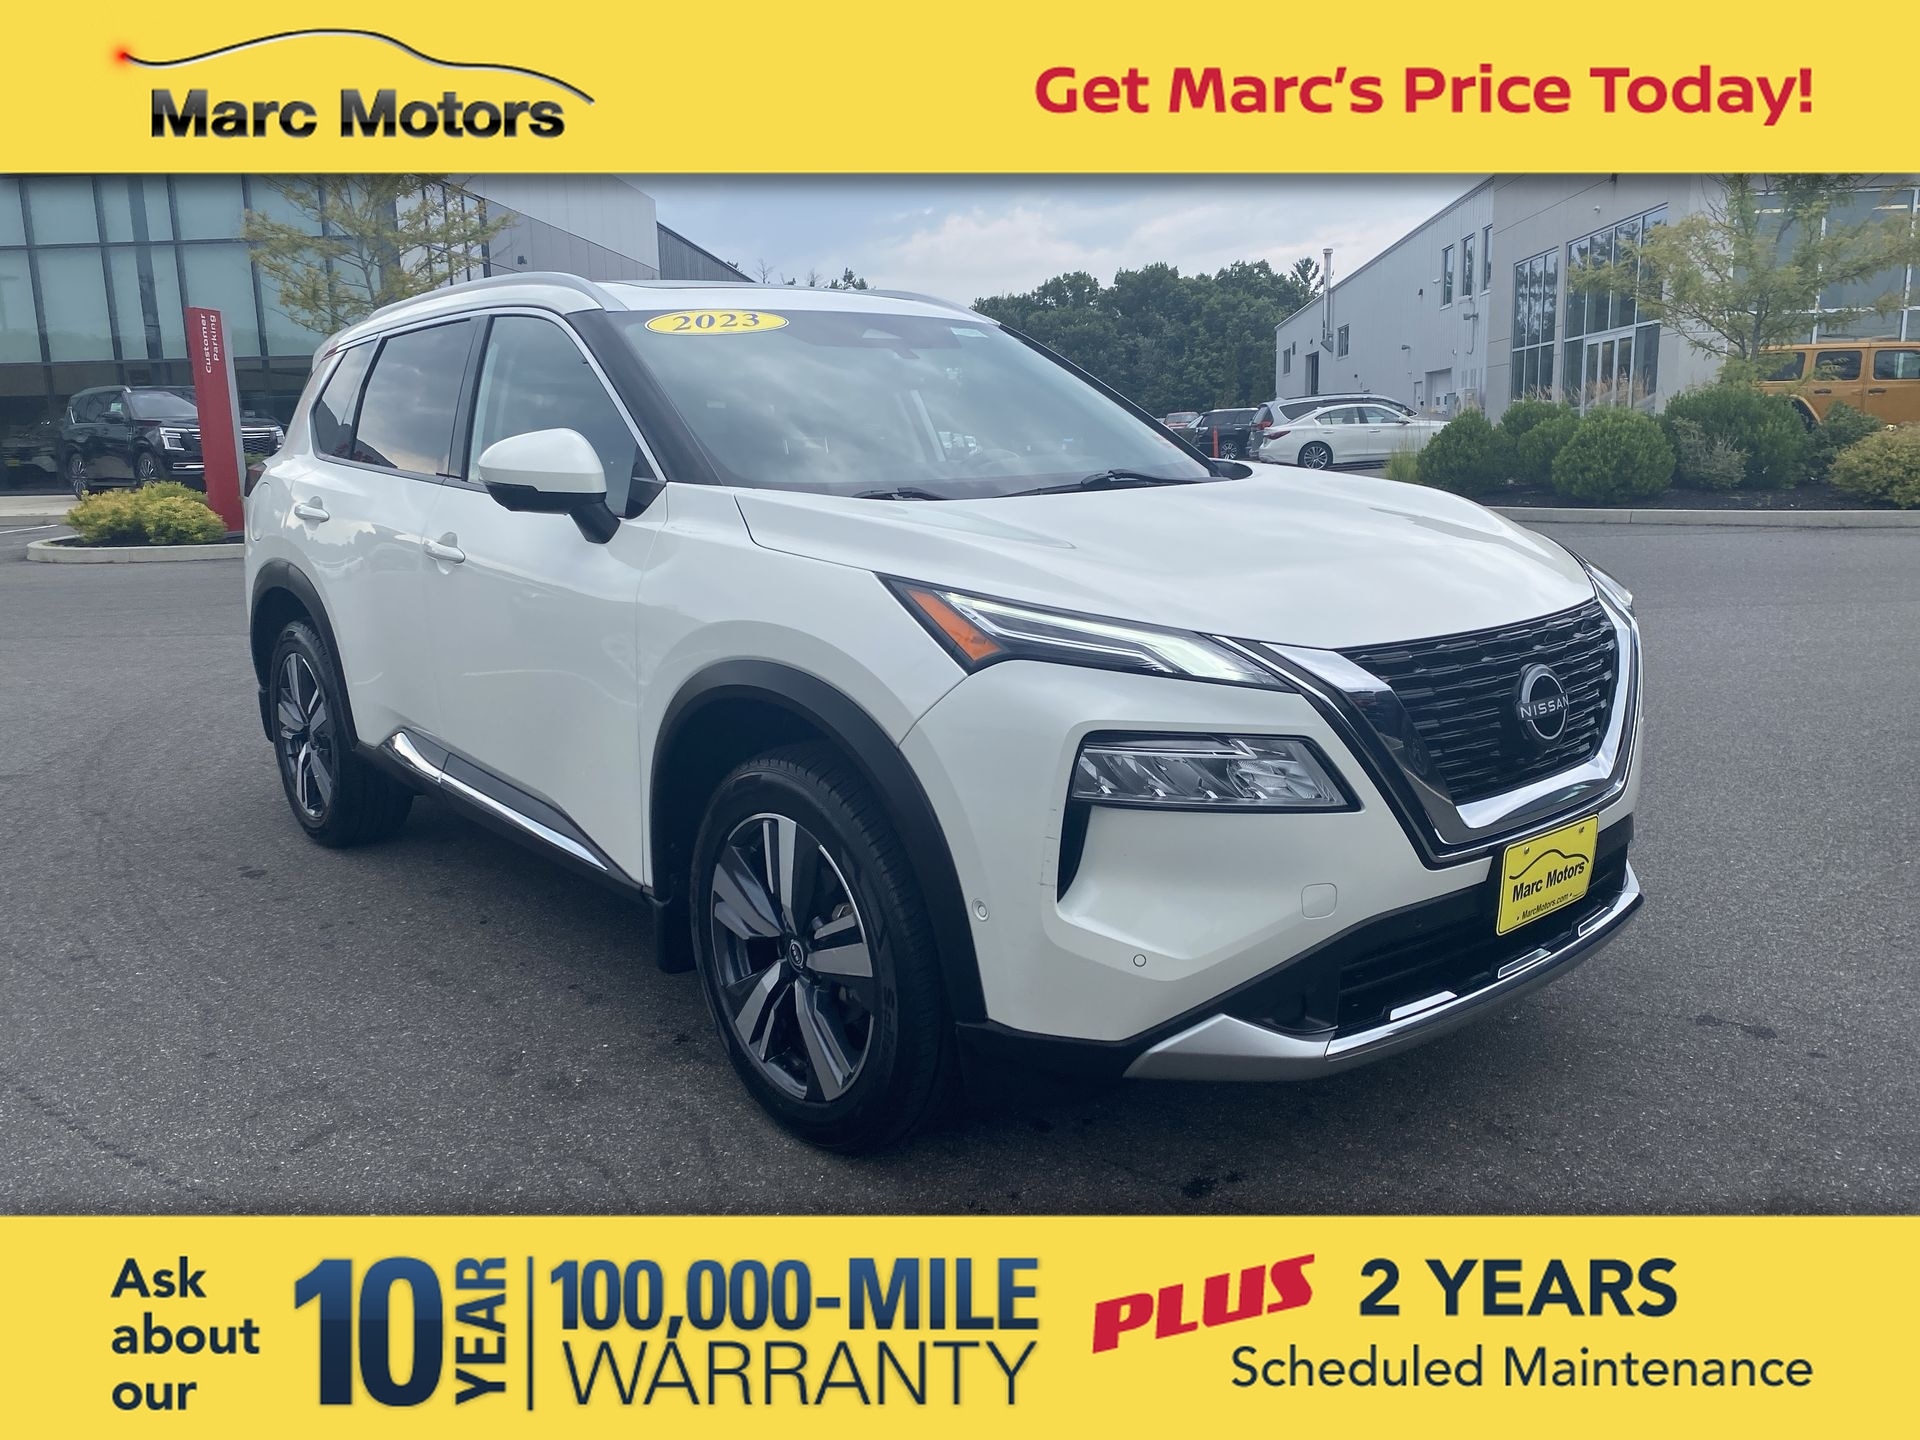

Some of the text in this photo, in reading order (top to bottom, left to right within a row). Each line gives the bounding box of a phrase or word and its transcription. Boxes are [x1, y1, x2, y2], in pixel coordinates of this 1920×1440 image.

[673, 313, 760, 331] 2023
[201, 314, 212, 373] Customer
[1520, 695, 1569, 718] NISSAN
[1512, 861, 1585, 903] Marc Motors
